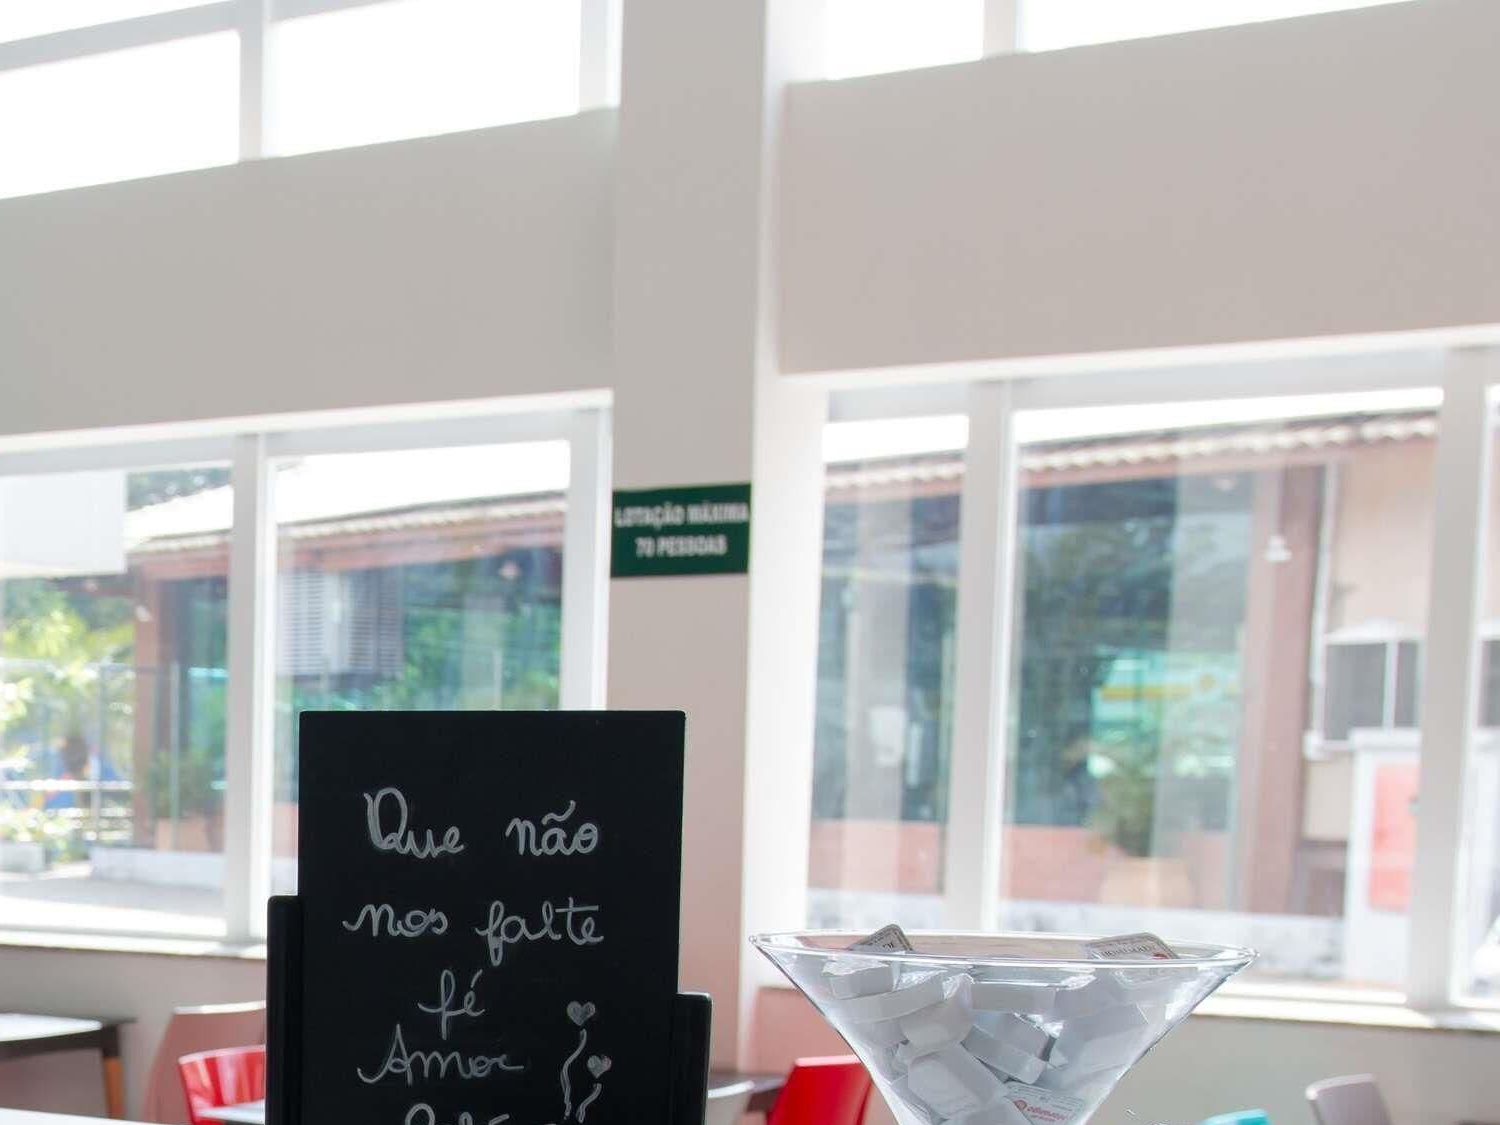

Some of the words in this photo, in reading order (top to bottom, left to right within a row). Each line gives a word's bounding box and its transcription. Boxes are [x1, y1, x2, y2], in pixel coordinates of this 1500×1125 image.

[614, 501, 685, 530] LOTAÇÃO
[686, 500, 749, 525] MÁXIMA
[657, 534, 728, 558] PESSOAS
[362, 786, 465, 859] Que
[505, 800, 600, 857] não
[342, 903, 449, 938] nos
[475, 897, 605, 966] falte
[418, 969, 487, 1041] fé
[357, 1023, 526, 1086] Amor
